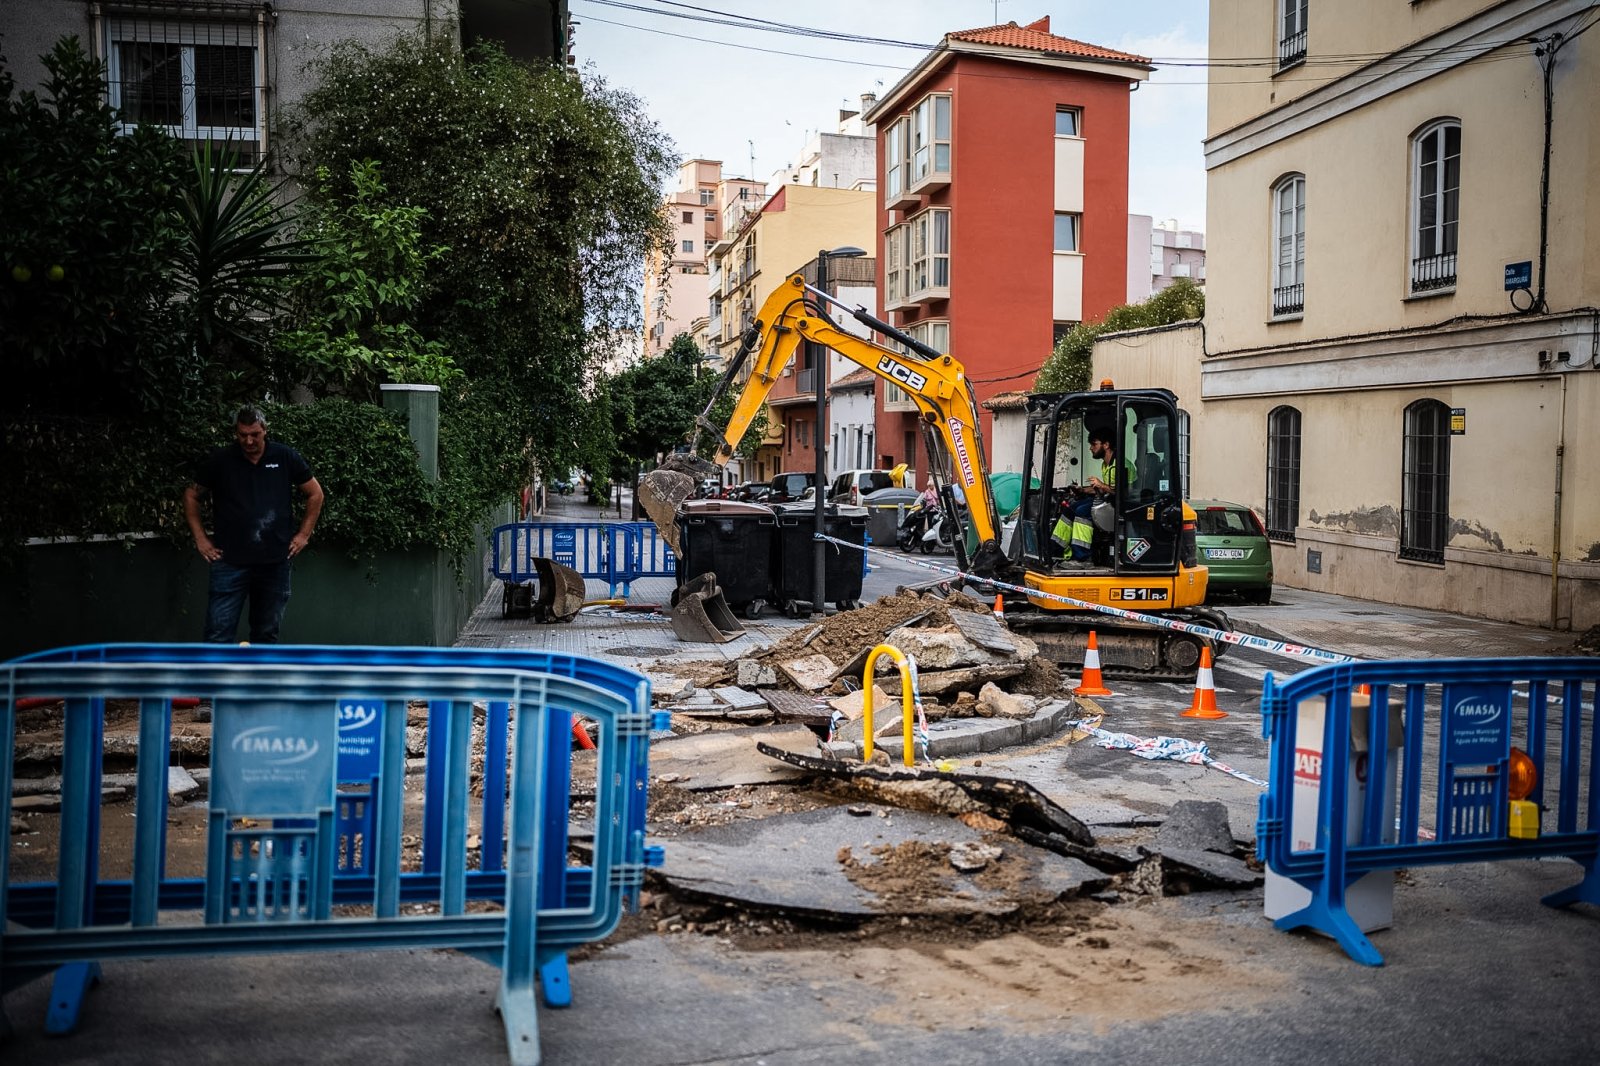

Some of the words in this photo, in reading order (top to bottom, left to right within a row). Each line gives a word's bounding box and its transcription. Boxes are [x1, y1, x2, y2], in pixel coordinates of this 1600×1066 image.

[878, 359, 926, 391] JCB
[950, 419, 975, 485] CONTORVER
[1123, 588, 1147, 600] 51
[1459, 704, 1496, 716] EMASA
[242, 737, 309, 753] EMASA
